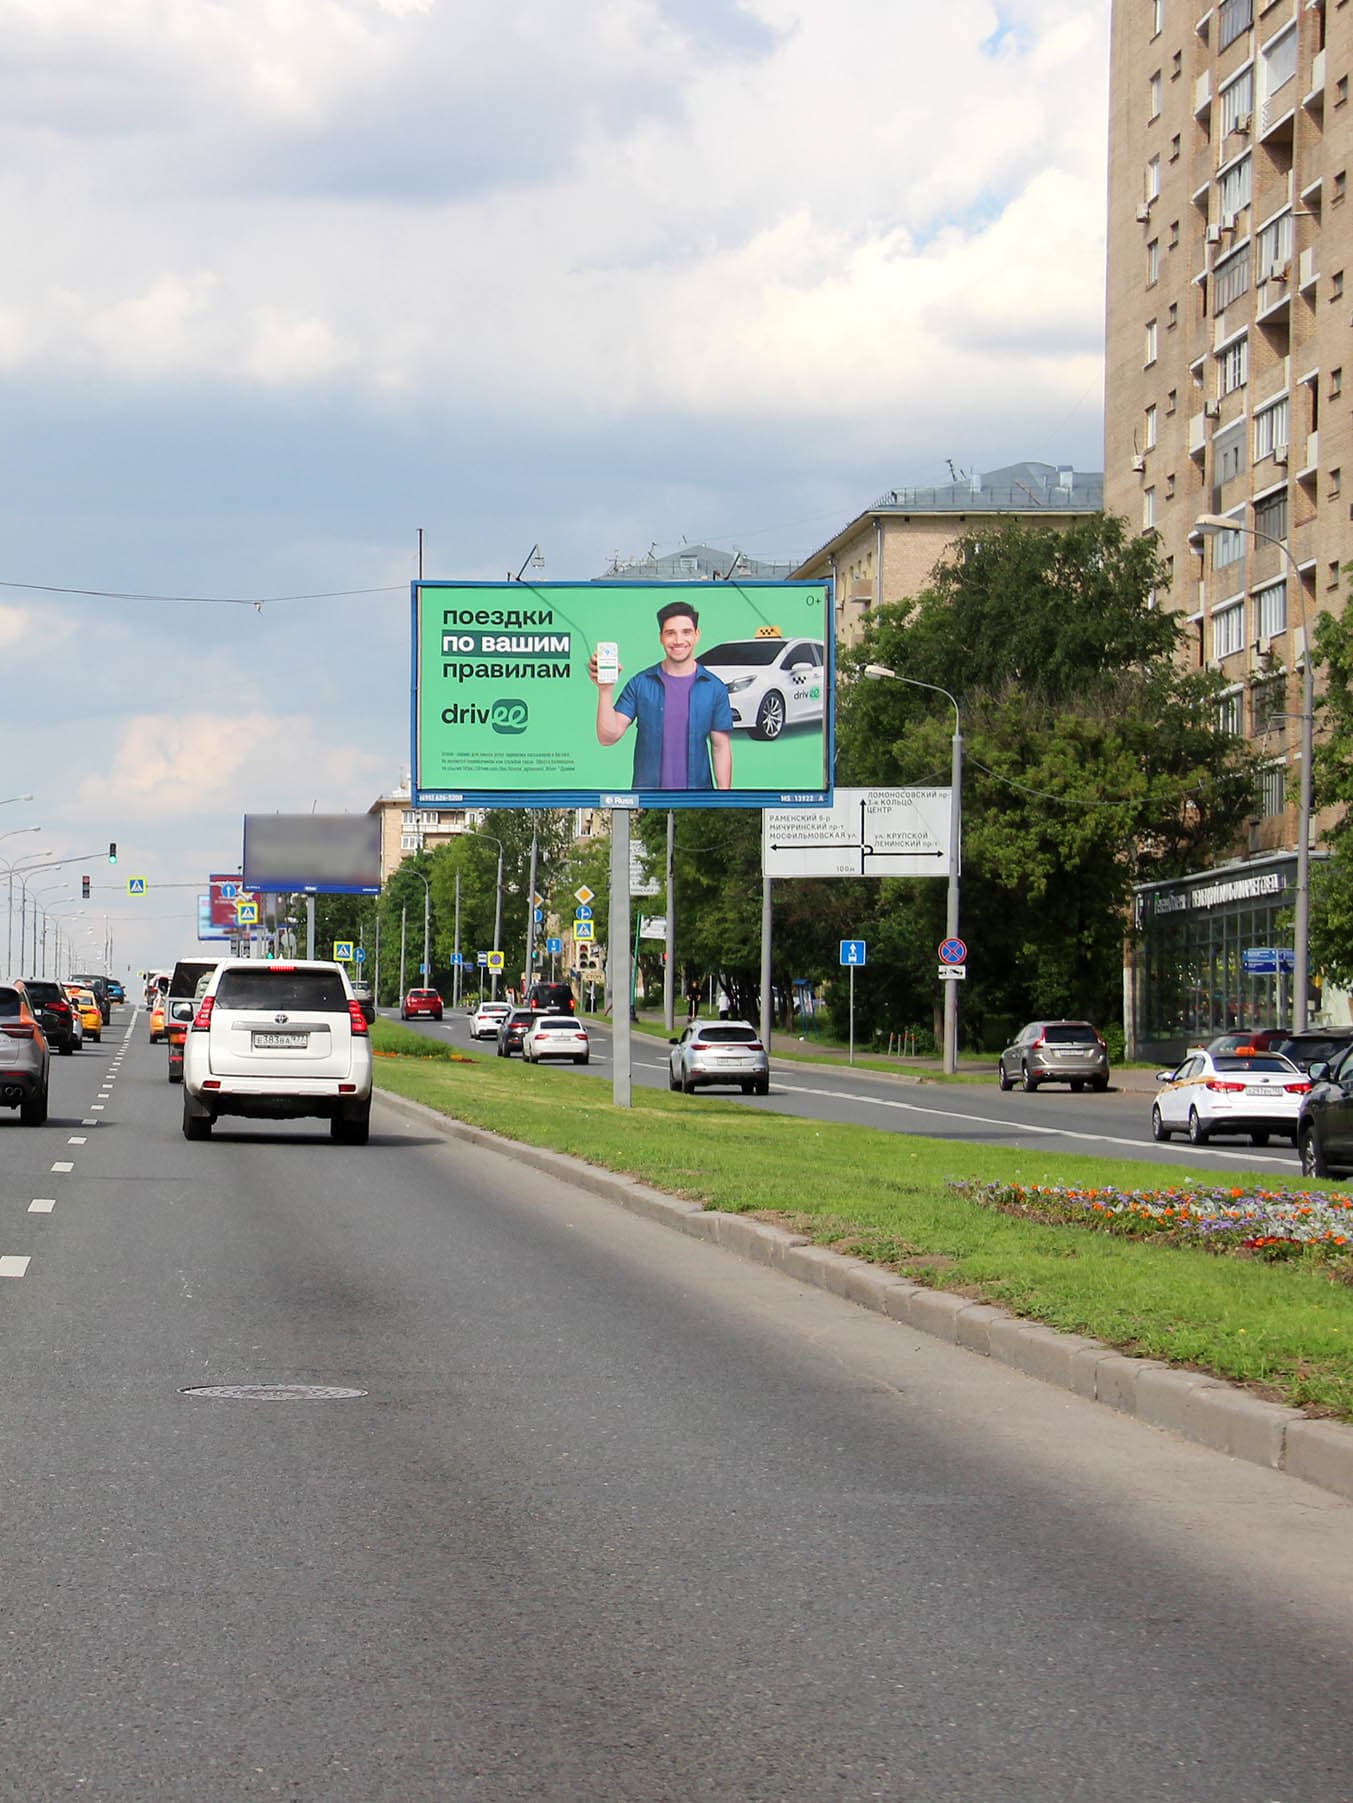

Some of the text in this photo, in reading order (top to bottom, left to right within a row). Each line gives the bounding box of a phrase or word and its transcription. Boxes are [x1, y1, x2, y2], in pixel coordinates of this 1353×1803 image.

[806, 595, 820, 606] 0+
[443, 610, 553, 628] поездки
[443, 635, 569, 652] по вашим
[443, 663, 570, 683] правилам
[441, 701, 528, 732] drivee
[867, 791, 937, 799] ЛОМОНОСОВСКИЙ
[867, 806, 892, 814] ЦЕНТР
[769, 814, 817, 822] РАМЕНСКИЙ
[769, 823, 828, 831] МИЧУРИНСКИЙ
[769, 832, 846, 840] МОСФИЛЬМОВСКАЯ
[886, 832, 928, 840] КРУПСКОЙ
[874, 840, 921, 848] ЛЕНИНСКИЙ
